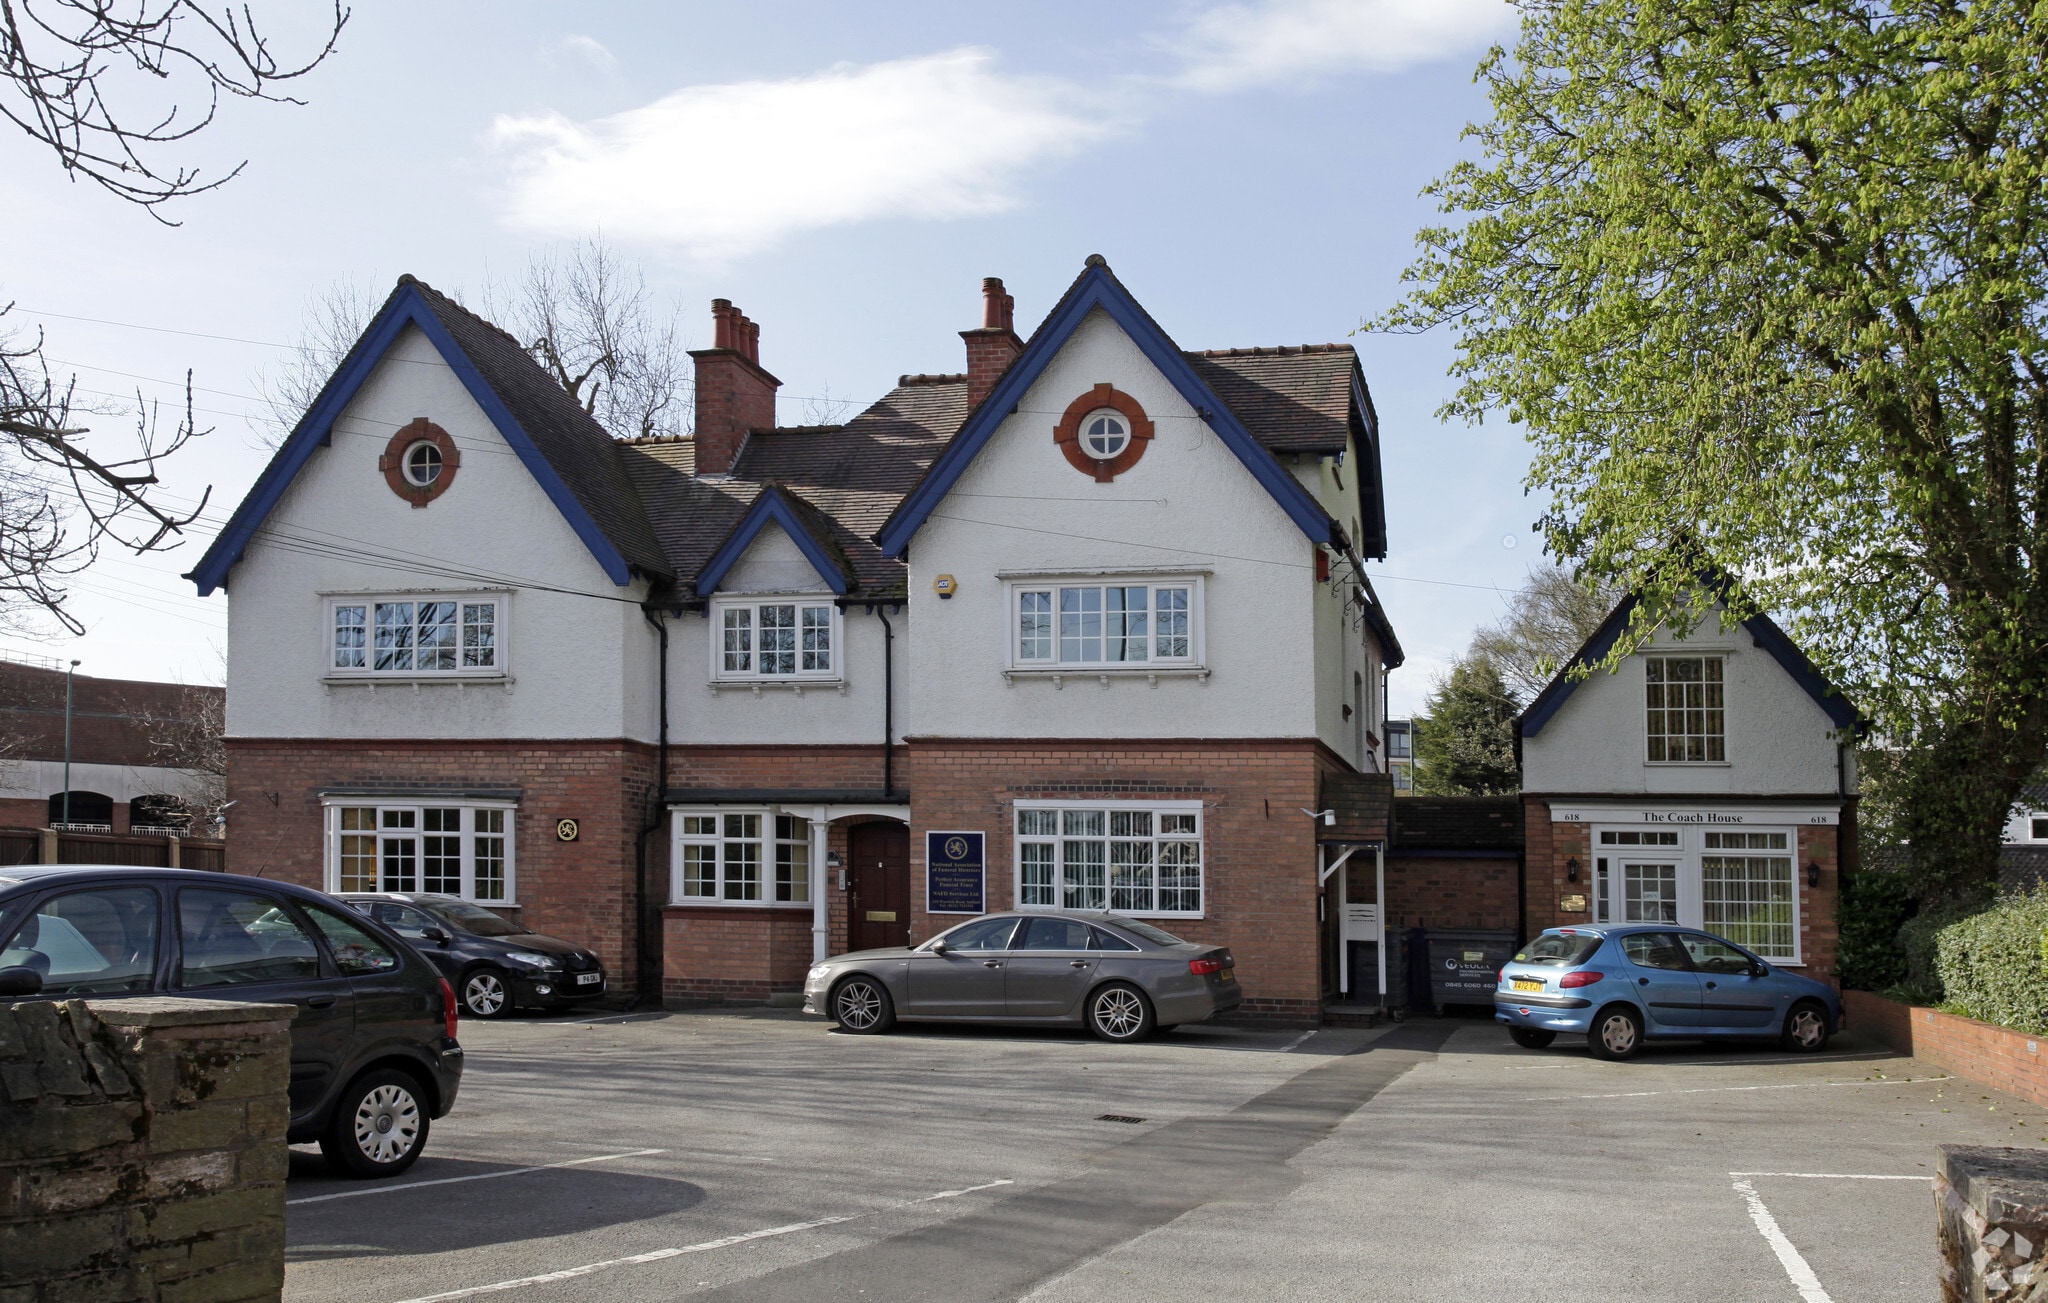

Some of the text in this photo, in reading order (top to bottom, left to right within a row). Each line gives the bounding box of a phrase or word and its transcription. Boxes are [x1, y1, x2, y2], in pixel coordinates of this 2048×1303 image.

[1564, 813, 1580, 821] 618
[1642, 812, 1743, 823] The Coach House
